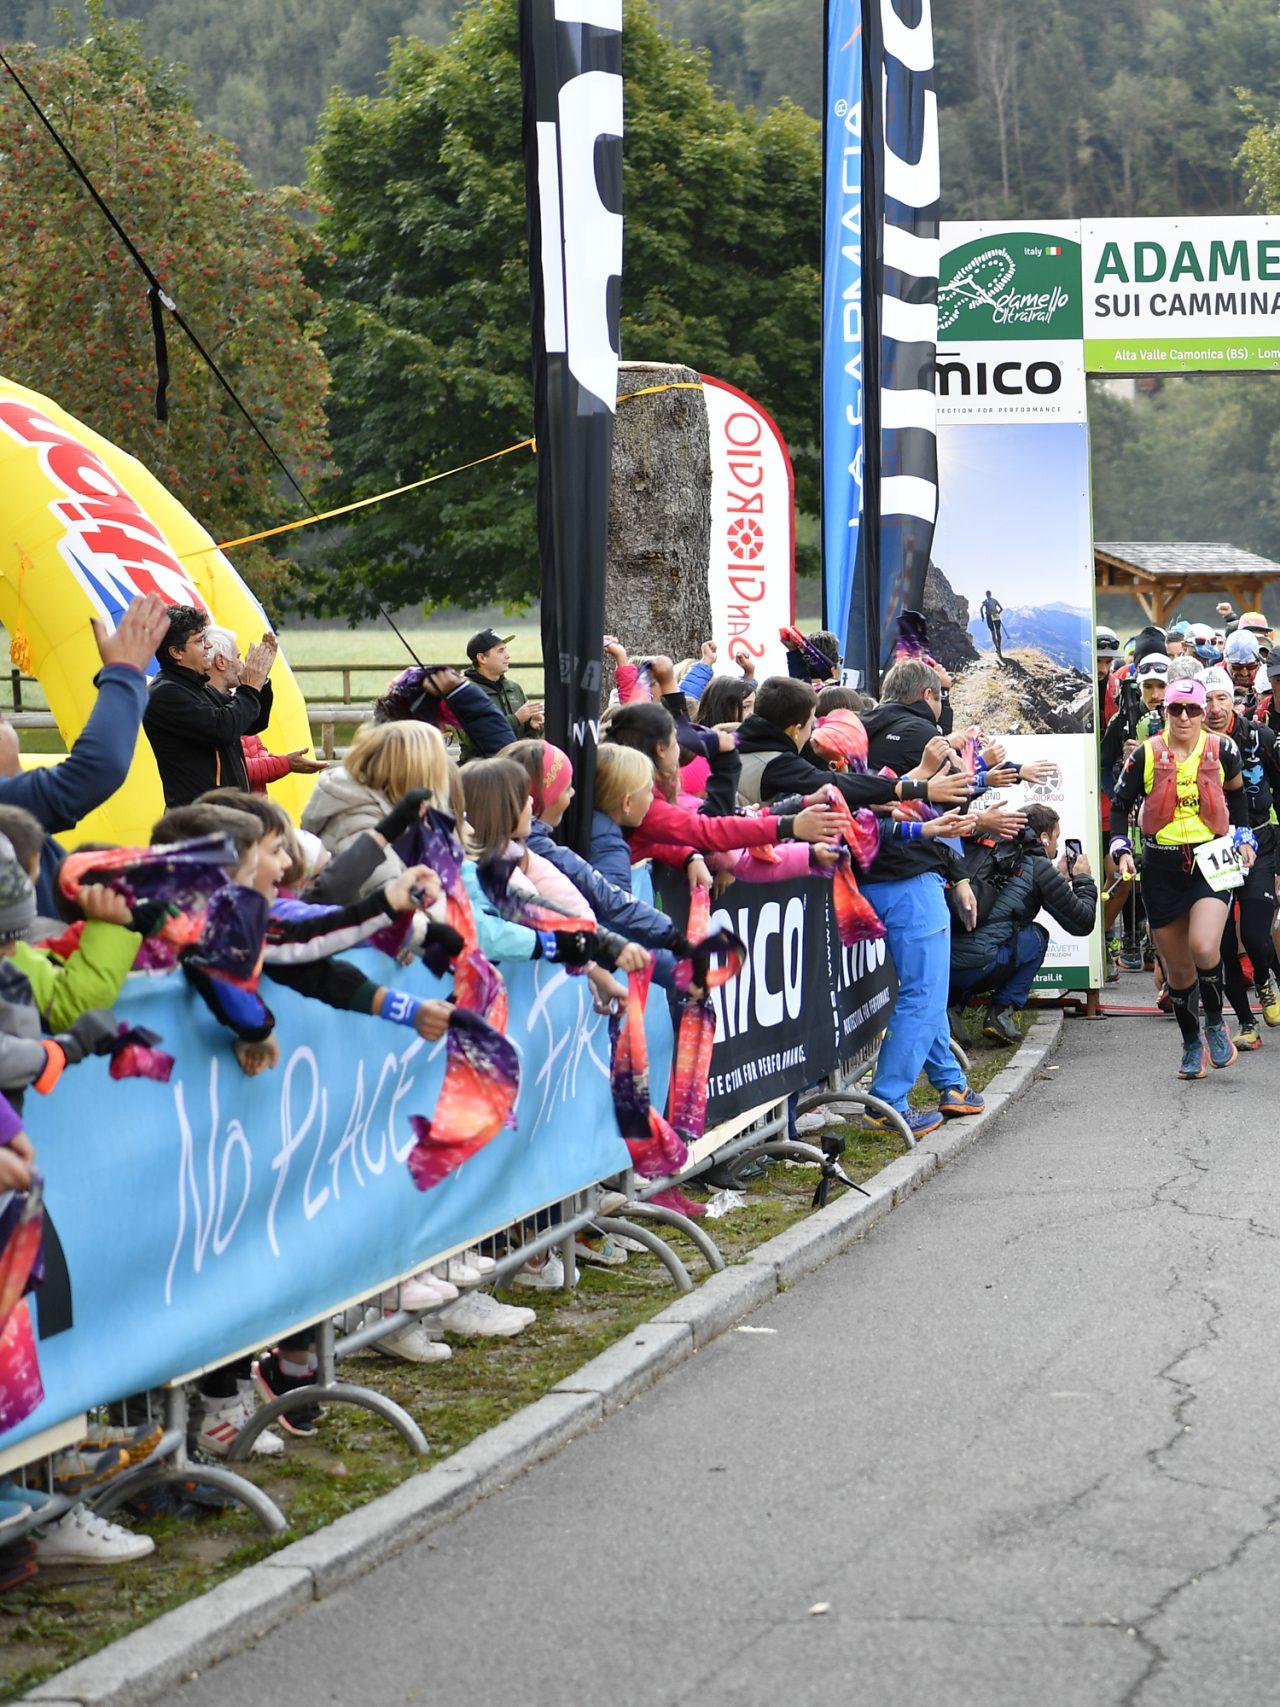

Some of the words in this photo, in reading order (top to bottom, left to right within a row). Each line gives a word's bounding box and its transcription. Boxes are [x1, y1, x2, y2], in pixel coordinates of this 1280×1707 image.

[1094, 293, 1140, 318] SUI
[1114, 349, 1137, 361] Alta
[1139, 348, 1167, 360] Valle
[1169, 347, 1224, 360] Camonica
[1226, 346, 1249, 361] (BS)
